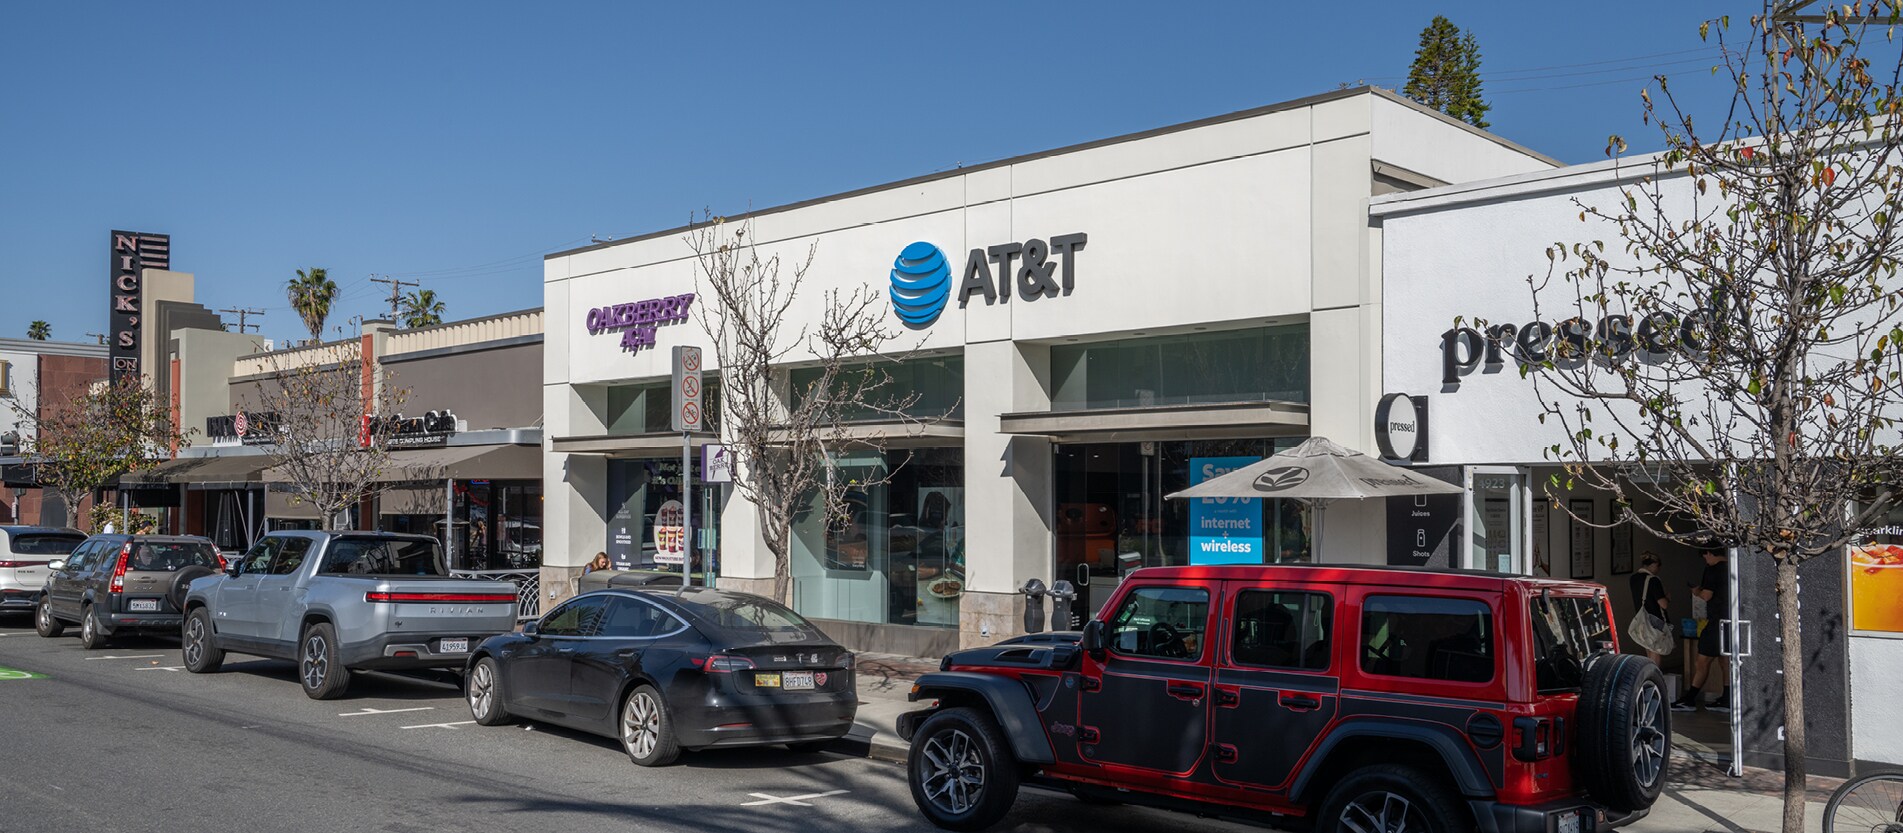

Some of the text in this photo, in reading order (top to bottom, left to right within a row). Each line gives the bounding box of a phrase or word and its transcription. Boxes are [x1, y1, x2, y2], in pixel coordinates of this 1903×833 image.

[958, 232, 1088, 303] AT&T
[115, 234, 138, 348] NICK'S
[586, 293, 695, 331] OAKBERRY
[1440, 285, 1729, 385] pressed
[115, 359, 137, 369] ON
[1390, 419, 1415, 434] pressed
[424, 435, 441, 443] HOUSE
[712, 457, 725, 465] OAK
[1478, 478, 1506, 489] 4923
[1201, 516, 1251, 529] internet
[1201, 540, 1251, 553] wireless
